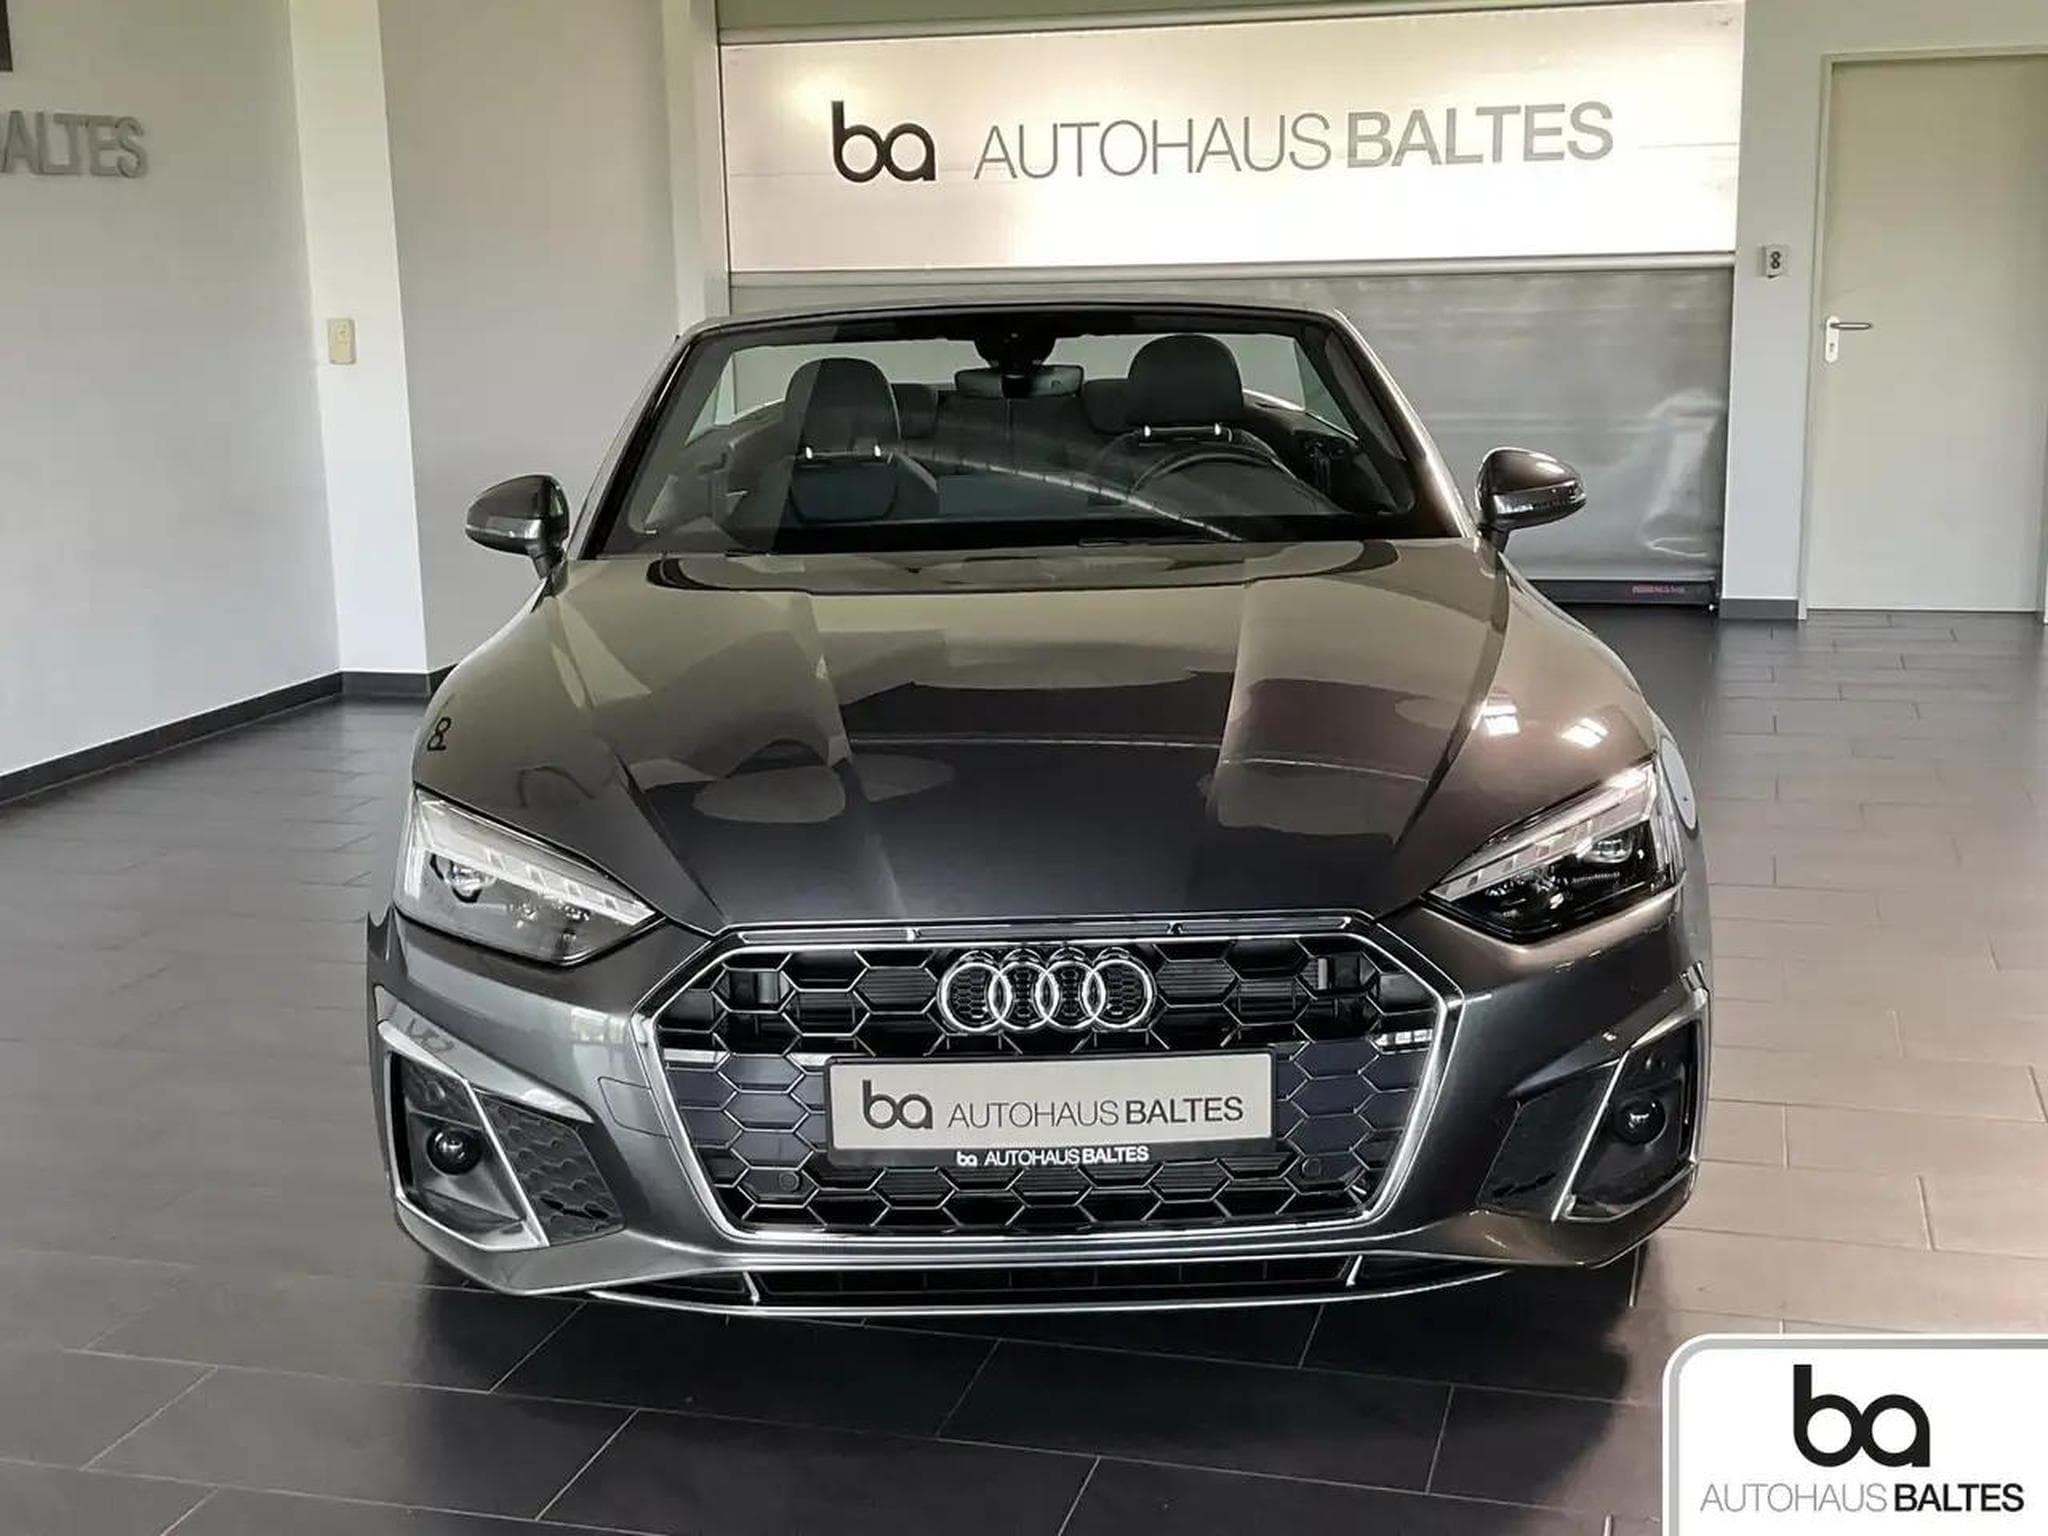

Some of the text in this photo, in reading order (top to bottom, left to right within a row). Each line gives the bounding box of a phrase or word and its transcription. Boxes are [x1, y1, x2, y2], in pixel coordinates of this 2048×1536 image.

[0, 109, 148, 178] ALTES
[832, 101, 1614, 182] ba AUTOHAUS BALTES
[862, 1079, 1244, 1130] ba AUTOHAUS BALTES
[956, 1145, 1150, 1167] ba AUTOHAUS BALTES
